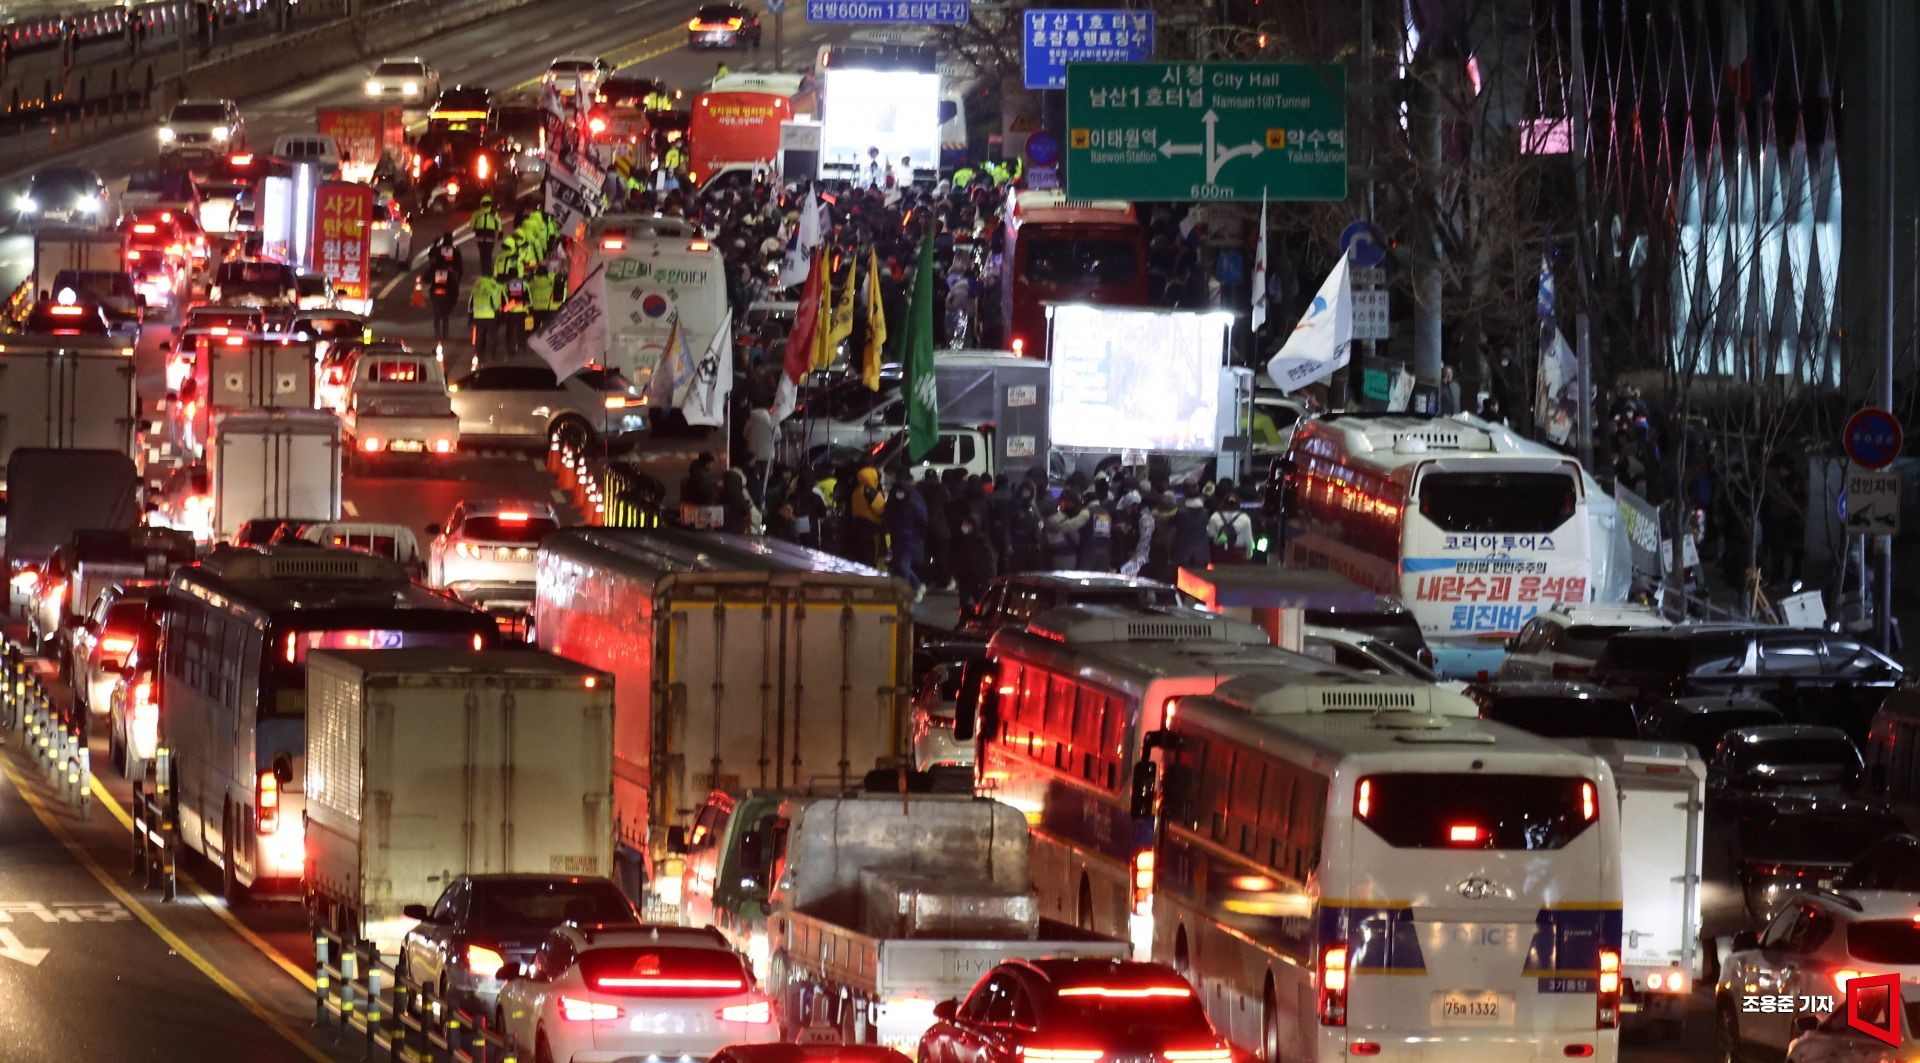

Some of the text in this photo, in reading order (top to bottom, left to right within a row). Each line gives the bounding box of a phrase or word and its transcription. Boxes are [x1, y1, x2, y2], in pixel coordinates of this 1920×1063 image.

[811, 2, 966, 20] 전방600m 1호터널구간
[1161, 65, 1204, 86] 시청
[1212, 71, 1280, 90] City Hall
[1089, 87, 1204, 109] 남산1호터널
[1212, 95, 1255, 109] Namsan
[1090, 128, 1157, 149] 이태원역
[1286, 129, 1345, 149] 약수역
[1090, 151, 1157, 164] Itaewon Station
[1314, 151, 1346, 164] Station
[1190, 184, 1234, 200] 600m
[324, 194, 363, 218] 사기
[322, 240, 362, 261] 원천
[1850, 477, 1897, 495] 견인지역
[1442, 535, 1556, 552] 코리아투어스
[1415, 576, 1587, 604] 내란수괴 윤석열
[810, 1031, 836, 1042] TAXI
